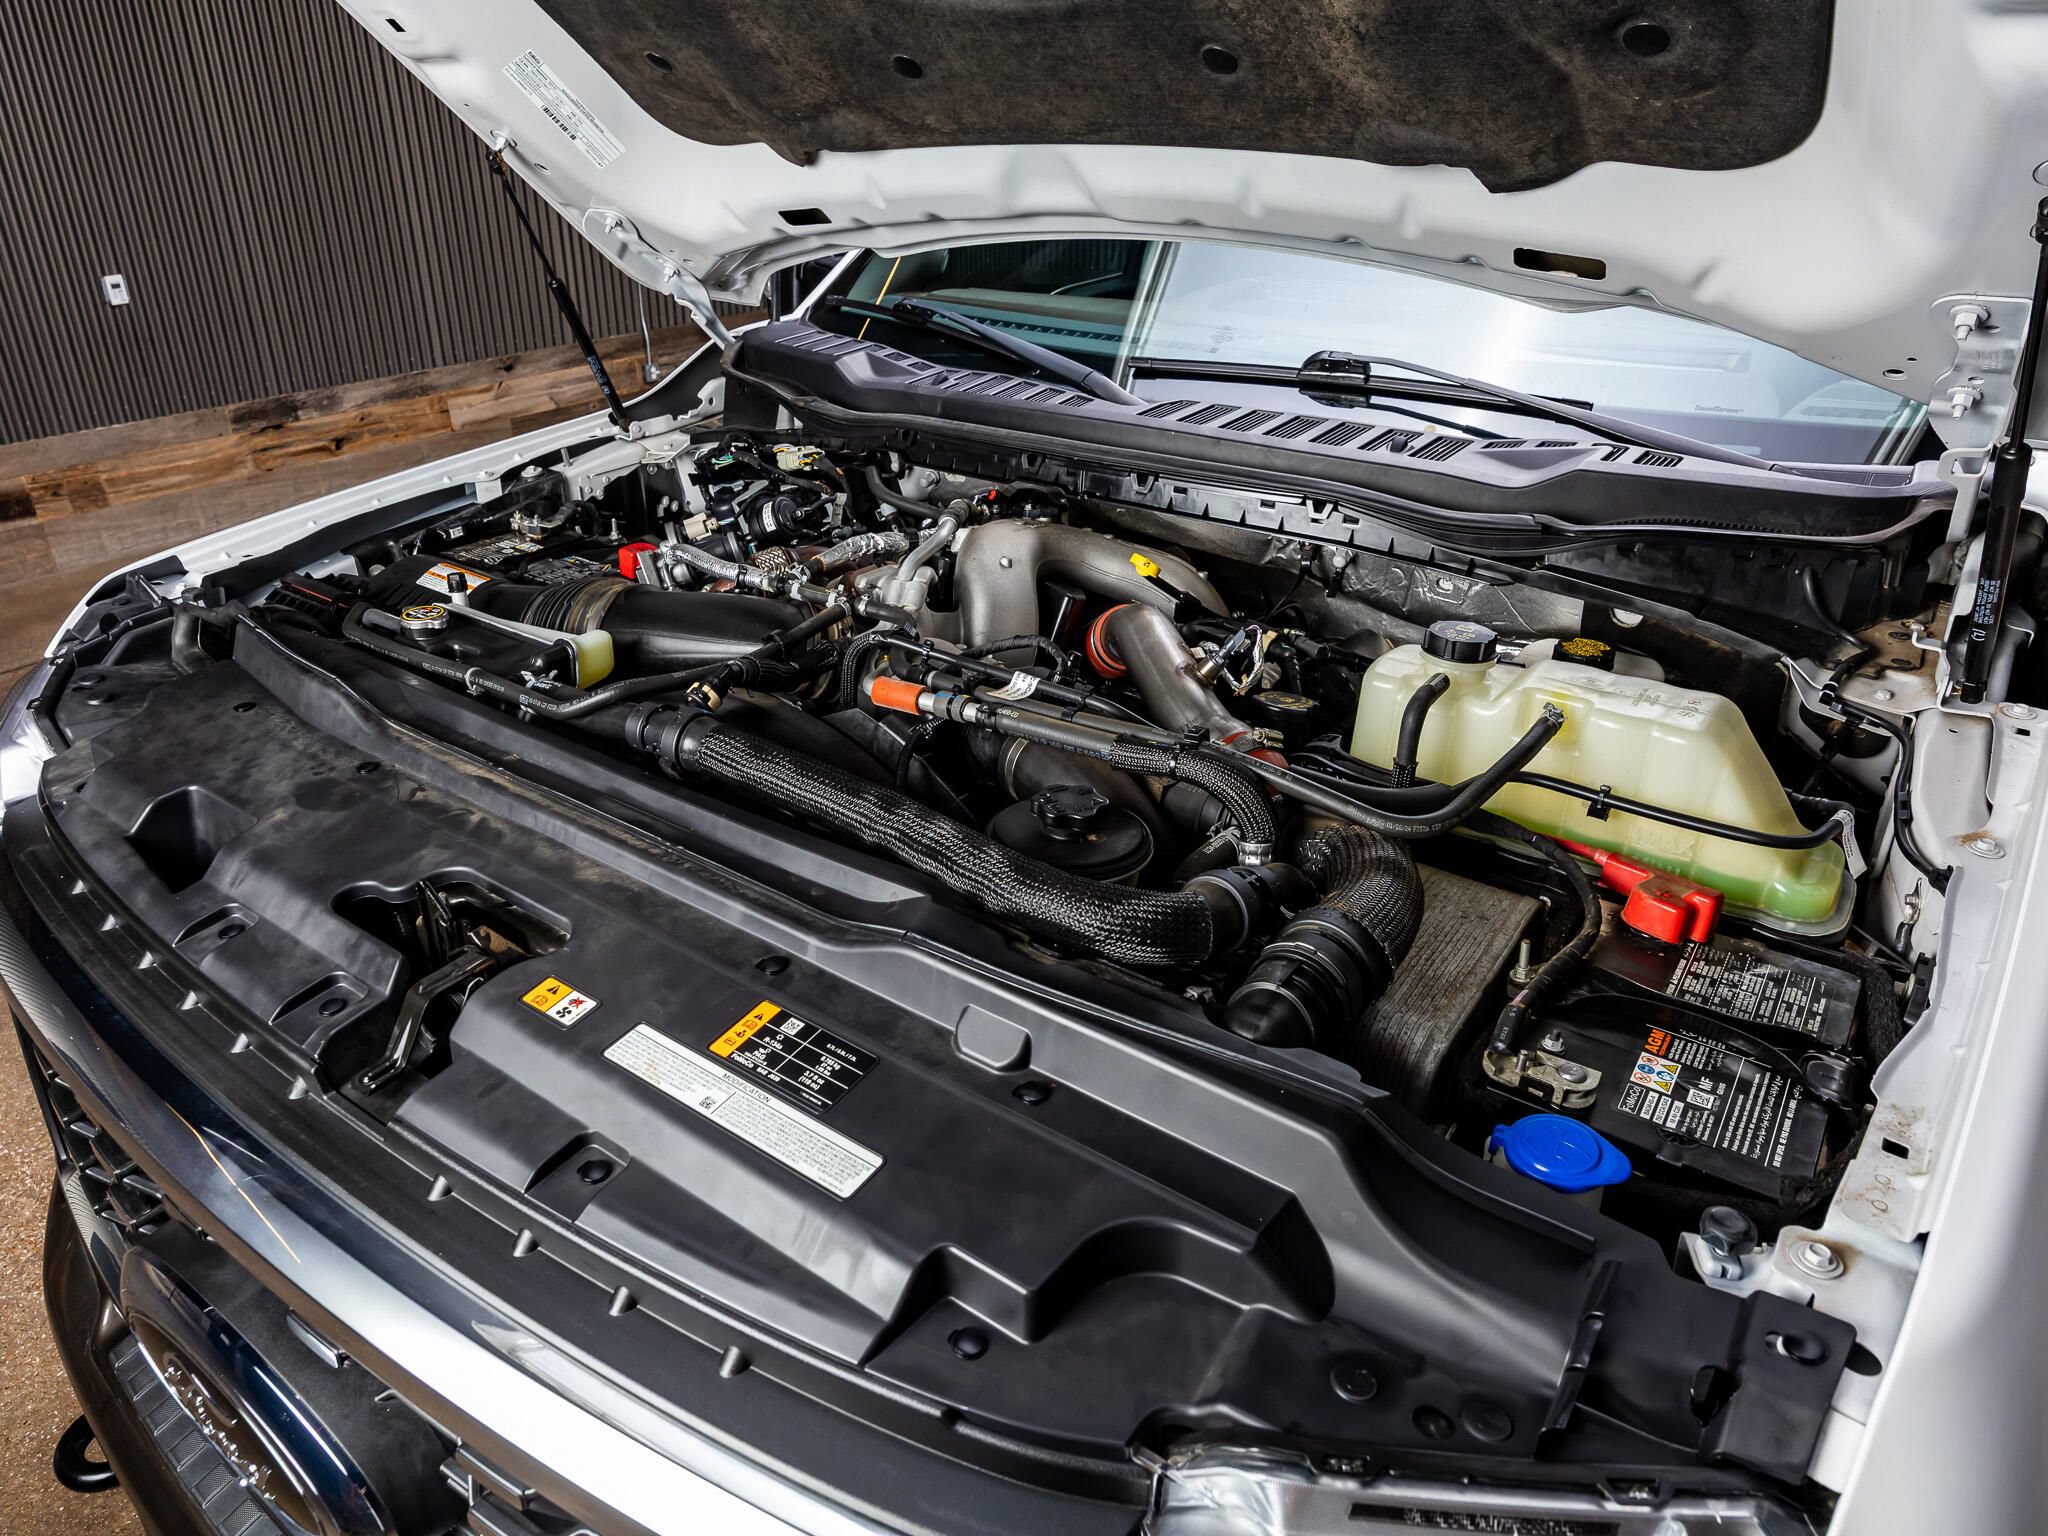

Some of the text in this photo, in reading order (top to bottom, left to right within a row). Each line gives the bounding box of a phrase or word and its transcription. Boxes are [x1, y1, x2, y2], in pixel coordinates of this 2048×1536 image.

[1643, 1027, 1665, 1054] AGM
[721, 1072, 772, 1103] MODIFICATION
[1698, 1075, 1714, 1091] MF
[1622, 1084, 1641, 1112] FoMoCo
